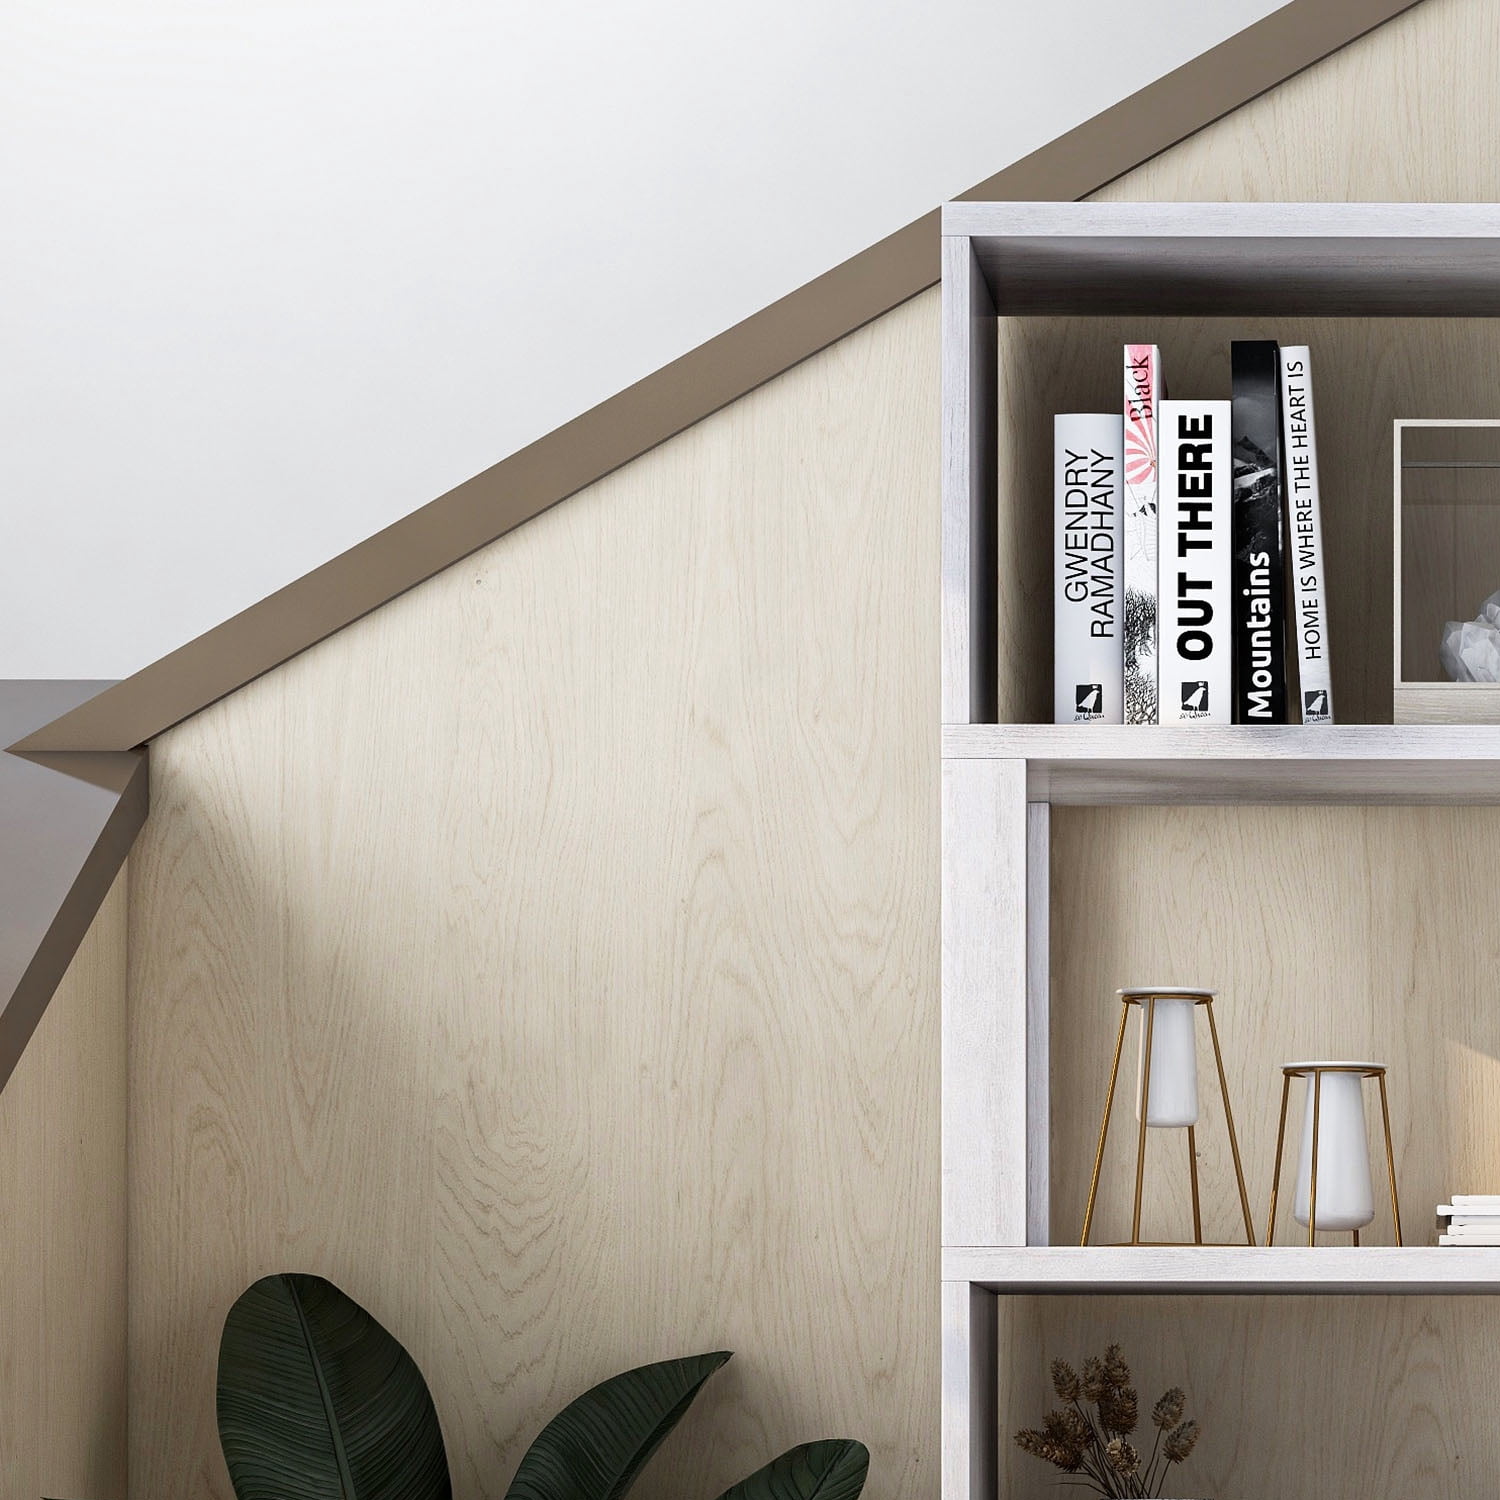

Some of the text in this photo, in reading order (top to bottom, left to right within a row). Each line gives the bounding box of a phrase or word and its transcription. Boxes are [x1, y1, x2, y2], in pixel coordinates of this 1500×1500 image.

[1126, 355, 1153, 422] Black
[1065, 449, 1088, 602] GWENDRY
[1091, 449, 1114, 637] RAMADHANY
[1177, 414, 1213, 660] OUT THERE
[1287, 361, 1321, 659] HOME IS WHERE THE HEART IS
[1243, 551, 1273, 718] Mountains
